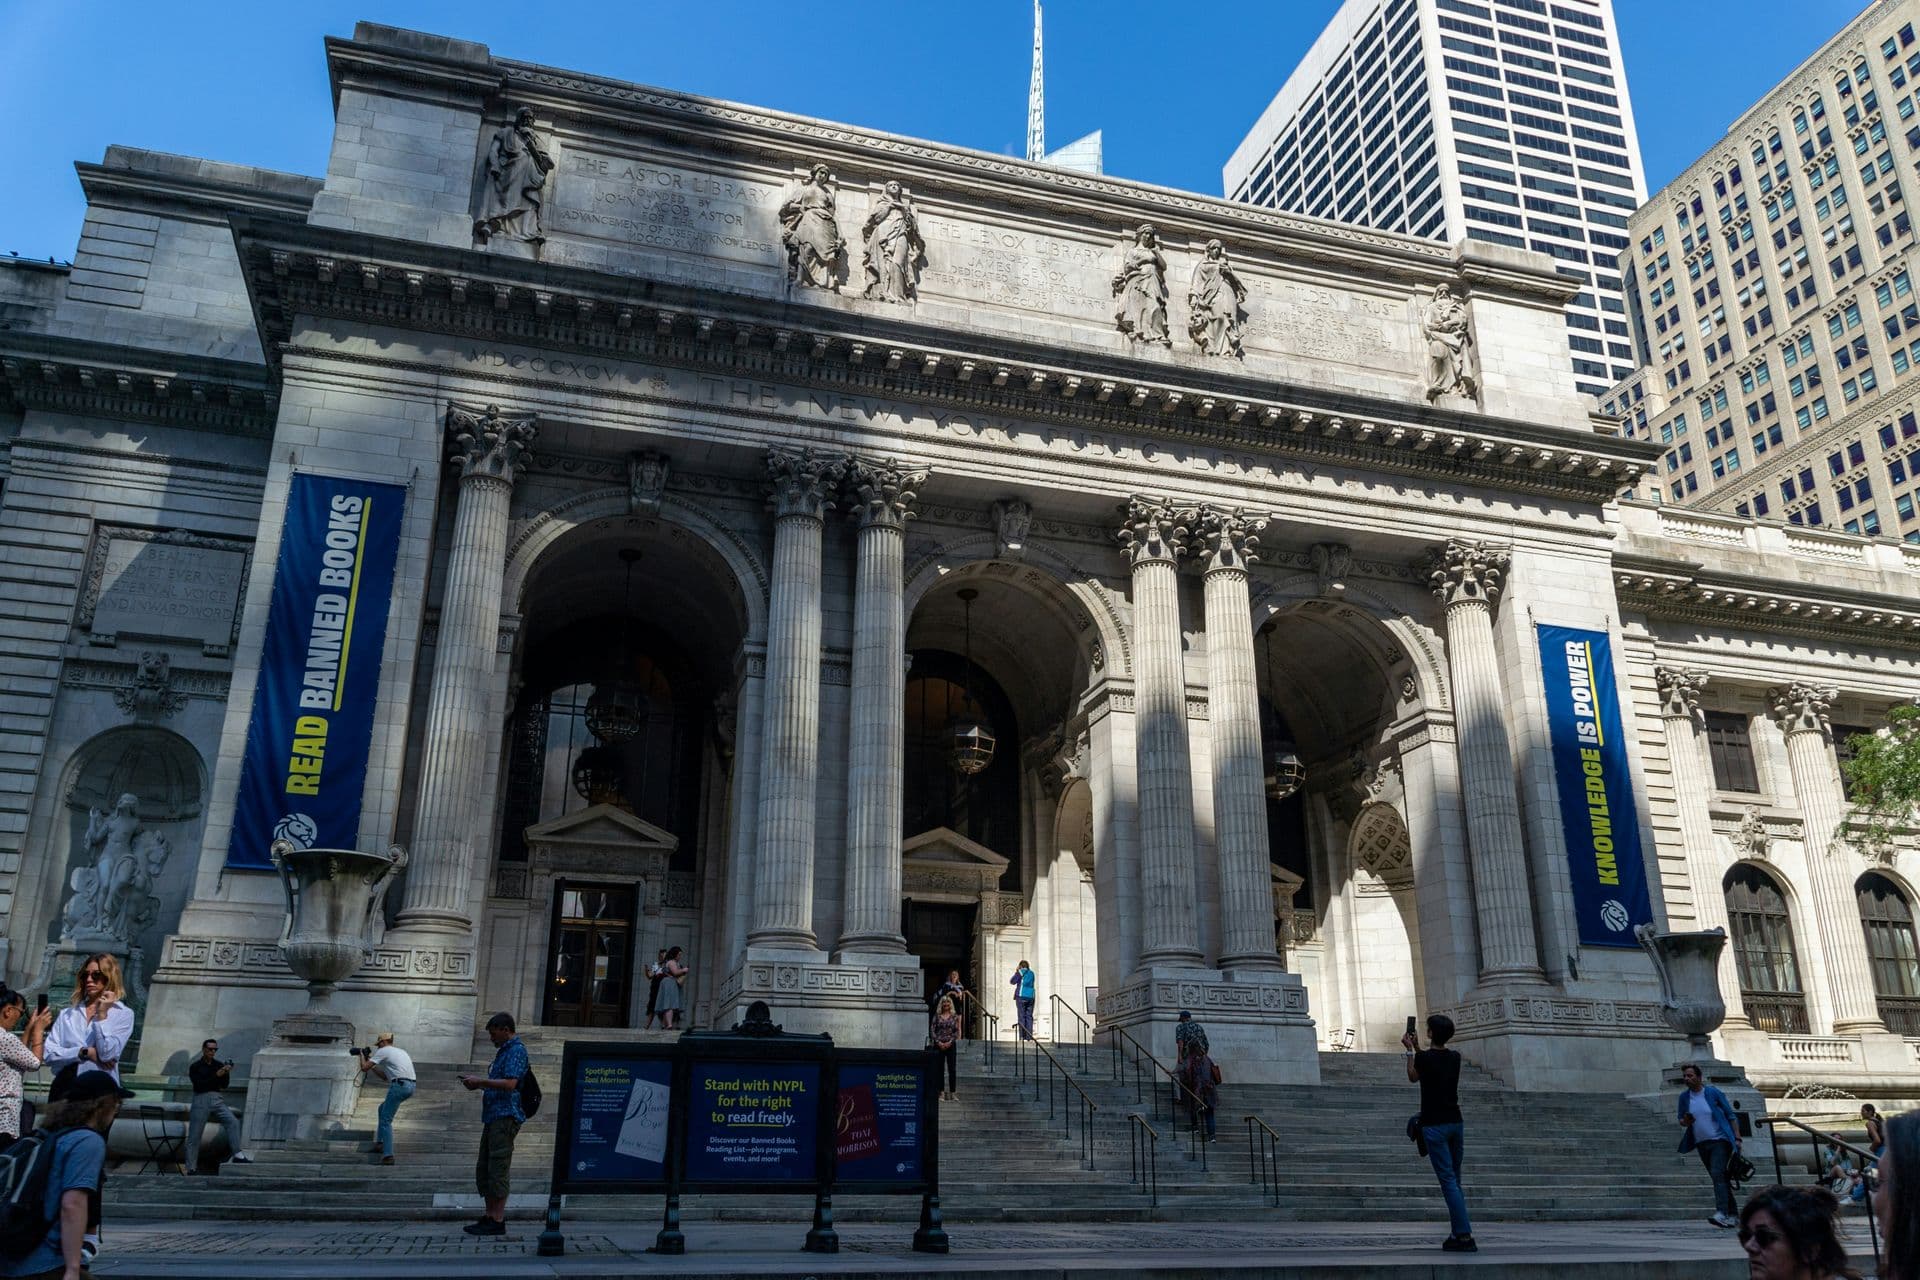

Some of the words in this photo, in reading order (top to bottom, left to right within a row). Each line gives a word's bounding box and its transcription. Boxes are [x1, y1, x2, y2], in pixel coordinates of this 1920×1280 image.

[572, 155, 609, 176] THE
[622, 167, 683, 189] ASTOR
[693, 177, 771, 203] LIBRARY
[631, 186, 686, 204] FOUNDED
[698, 199, 711, 209] BY
[595, 191, 635, 207] JOHN
[641, 199, 690, 217] JACOB
[698, 210, 744, 226] ASTOR
[641, 211, 665, 223] FOR
[672, 216, 695, 229] THE
[561, 210, 647, 230] ADVANCEMENT
[648, 224, 664, 234] OF
[709, 232, 774, 253] KNOWLEDGE
[928, 220, 962, 240] THE
[969, 227, 1026, 251] LENOX
[1035, 239, 1104, 265] LIBRARY
[981, 248, 1029, 266] FOUNDED
[1040, 259, 1053, 269] BY
[923, 270, 992, 290] LITERATURE
[951, 265, 1009, 283] DEDICATED
[1014, 275, 1030, 287] TO
[967, 256, 1012, 274] JAMES
[1021, 264, 1067, 283] LENOX
[1241, 277, 1273, 297] THE
[1284, 285, 1340, 307] TILDEN
[1350, 296, 1399, 317] TRUST
[701, 376, 778, 409] THE
[808, 390, 897, 424] NEW
[928, 409, 1015, 443] YORK
[1046, 427, 1161, 464] PUBLIC
[1191, 448, 1319, 486] LIBRARY
[319, 494, 363, 589] BOOKS
[147, 548, 207, 562] BEAUTY
[168, 567, 201, 582] EVER
[184, 587, 228, 602] VOICE
[299, 593, 348, 711] BANNED
[1565, 640, 1594, 717] POWER
[1576, 721, 1598, 744] IS
[285, 714, 329, 796] READ
[1580, 747, 1620, 886] KNOWLEDGE
[584, 1067, 616, 1077] Spotlight
[600, 1076, 631, 1085] Morrison
[876, 1073, 905, 1083] Spotlight
[704, 1079, 740, 1092] Stand
[742, 1079, 770, 1092] with
[772, 1080, 806, 1093] NYPL
[889, 1082, 917, 1090] Morrison
[718, 1094, 737, 1107] for
[739, 1095, 760, 1107] the
[762, 1096, 792, 1111] right
[711, 1111, 726, 1123] to
[728, 1111, 756, 1124] read
[758, 1111, 796, 1127] freely.
[706, 1146, 733, 1156] Reading
[766, 1147, 798, 1156] programs,
[709, 1136, 738, 1145] Discover
[751, 1137, 776, 1145] Banned
[776, 1137, 796, 1145] Books
[723, 1156, 747, 1164] events,
[761, 1156, 781, 1164] more!
